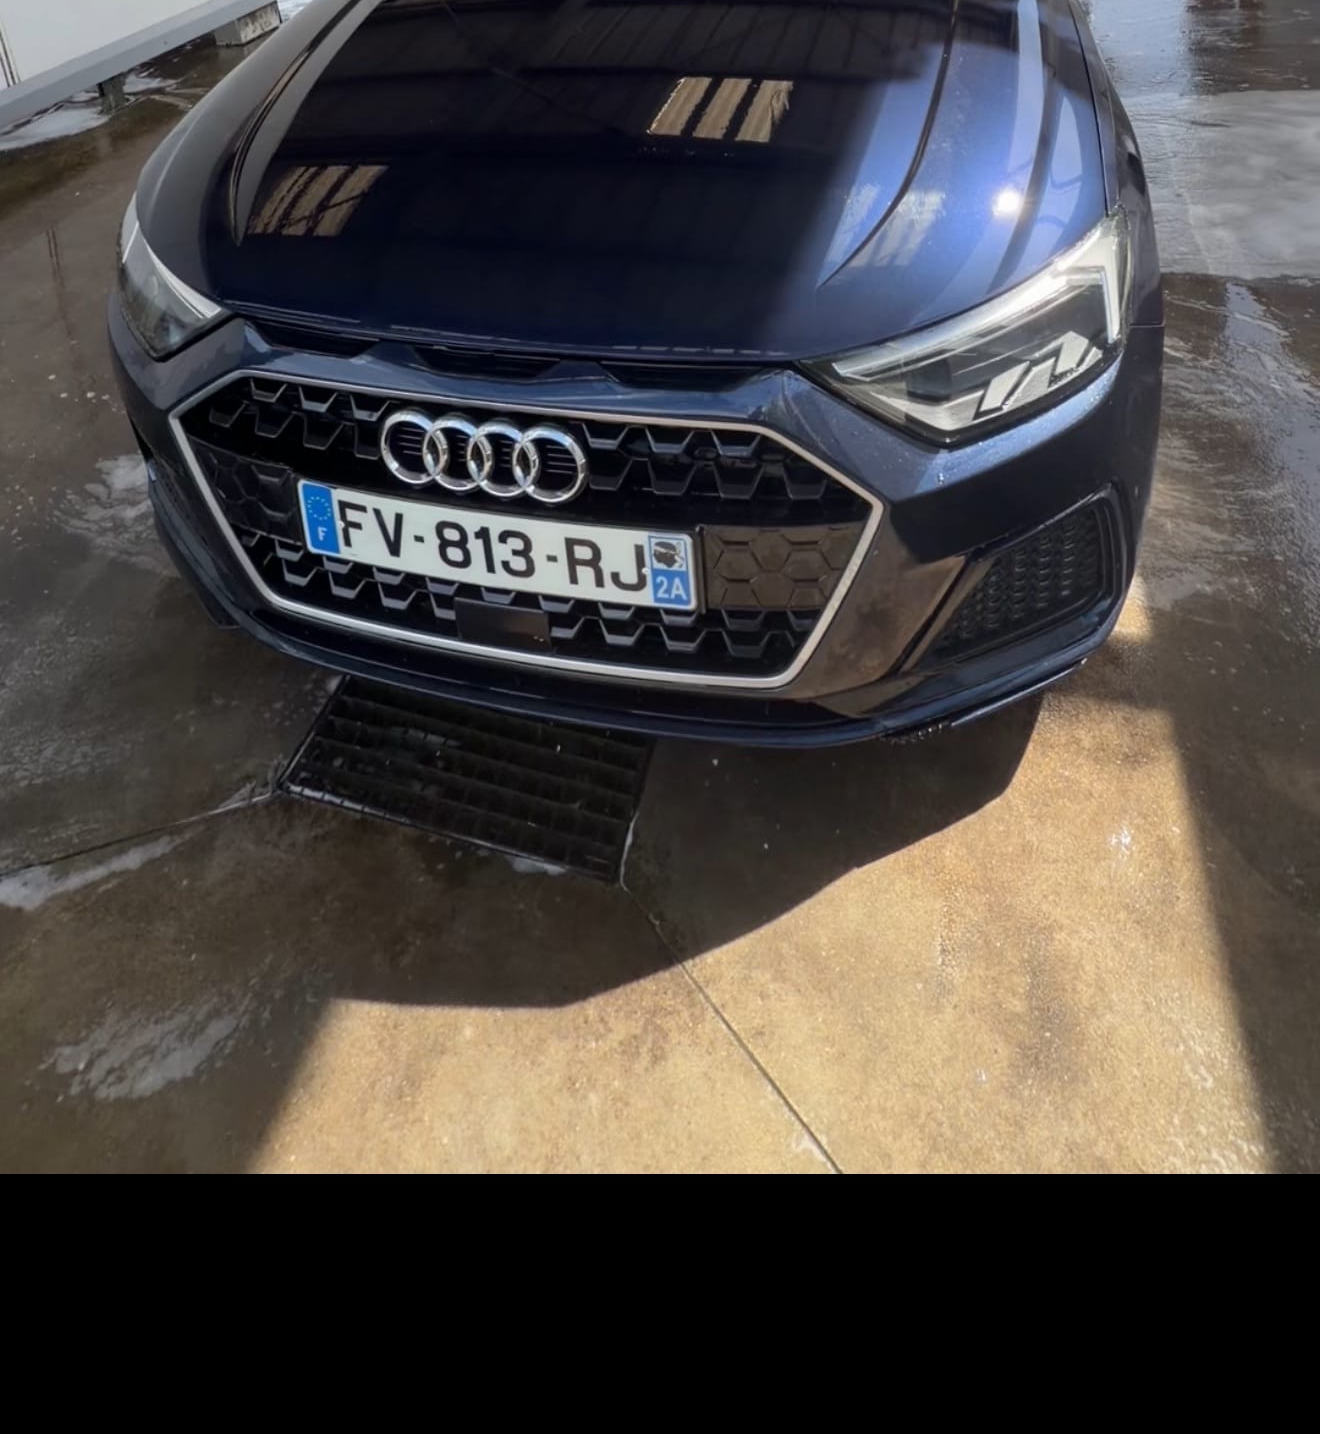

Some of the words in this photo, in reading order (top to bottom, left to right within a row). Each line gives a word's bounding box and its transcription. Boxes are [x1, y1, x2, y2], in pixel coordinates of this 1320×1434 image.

[317, 526, 328, 542] F
[338, 499, 647, 591] FV-813-RJ
[656, 575, 687, 600] 2A
